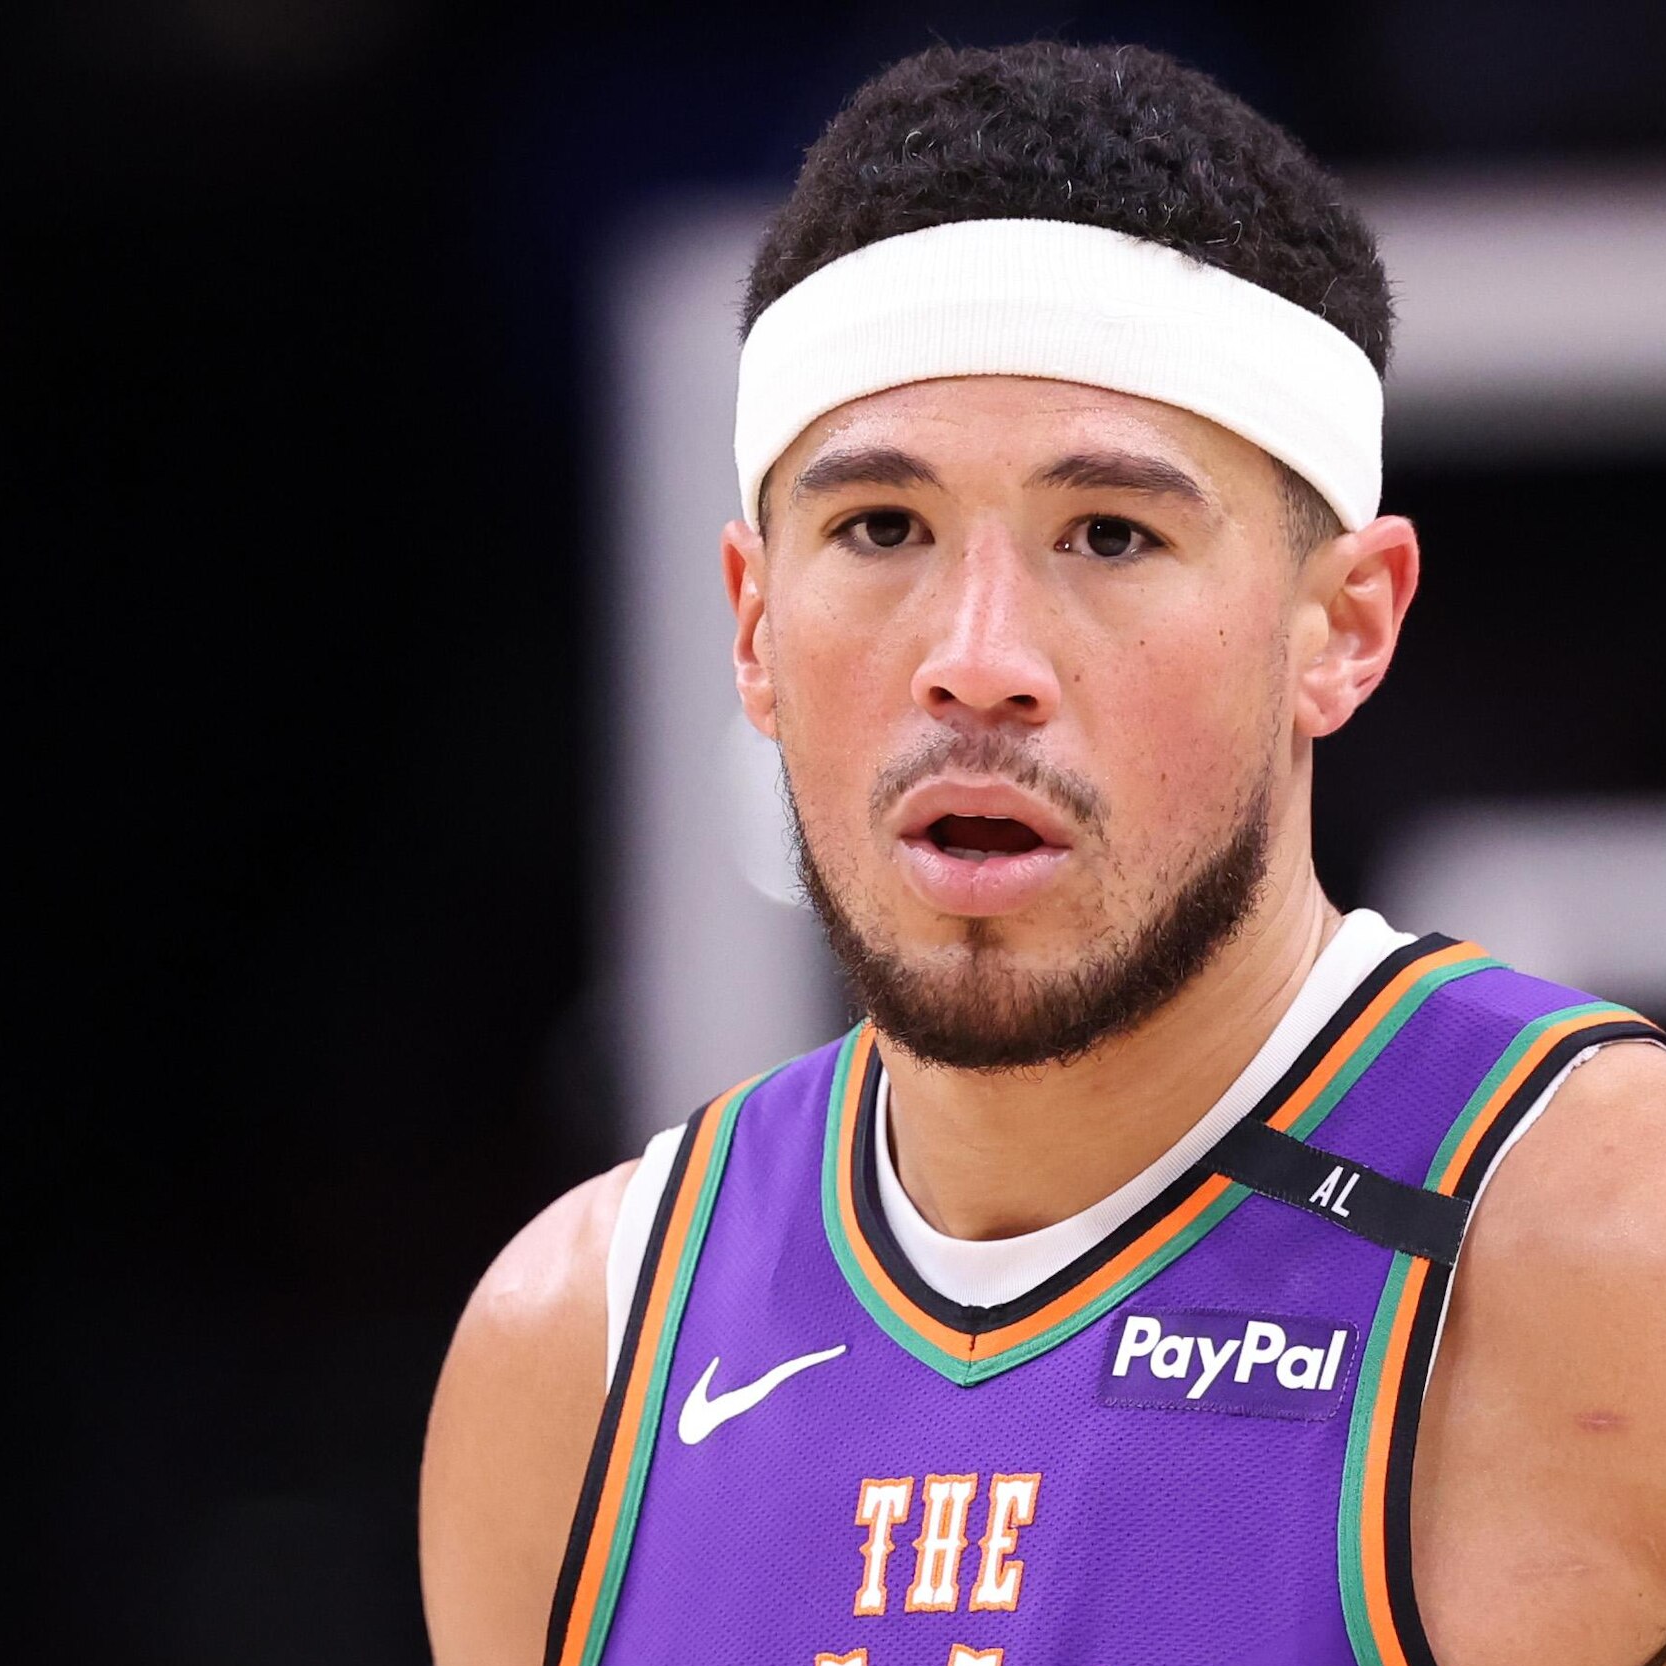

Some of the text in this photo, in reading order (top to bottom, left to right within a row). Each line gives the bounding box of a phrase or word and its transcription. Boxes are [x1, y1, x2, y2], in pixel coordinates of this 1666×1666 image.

[1308, 1165, 1359, 1218] AL
[1111, 1315, 1347, 1399] PayPal
[853, 1472, 1042, 1616] THE
